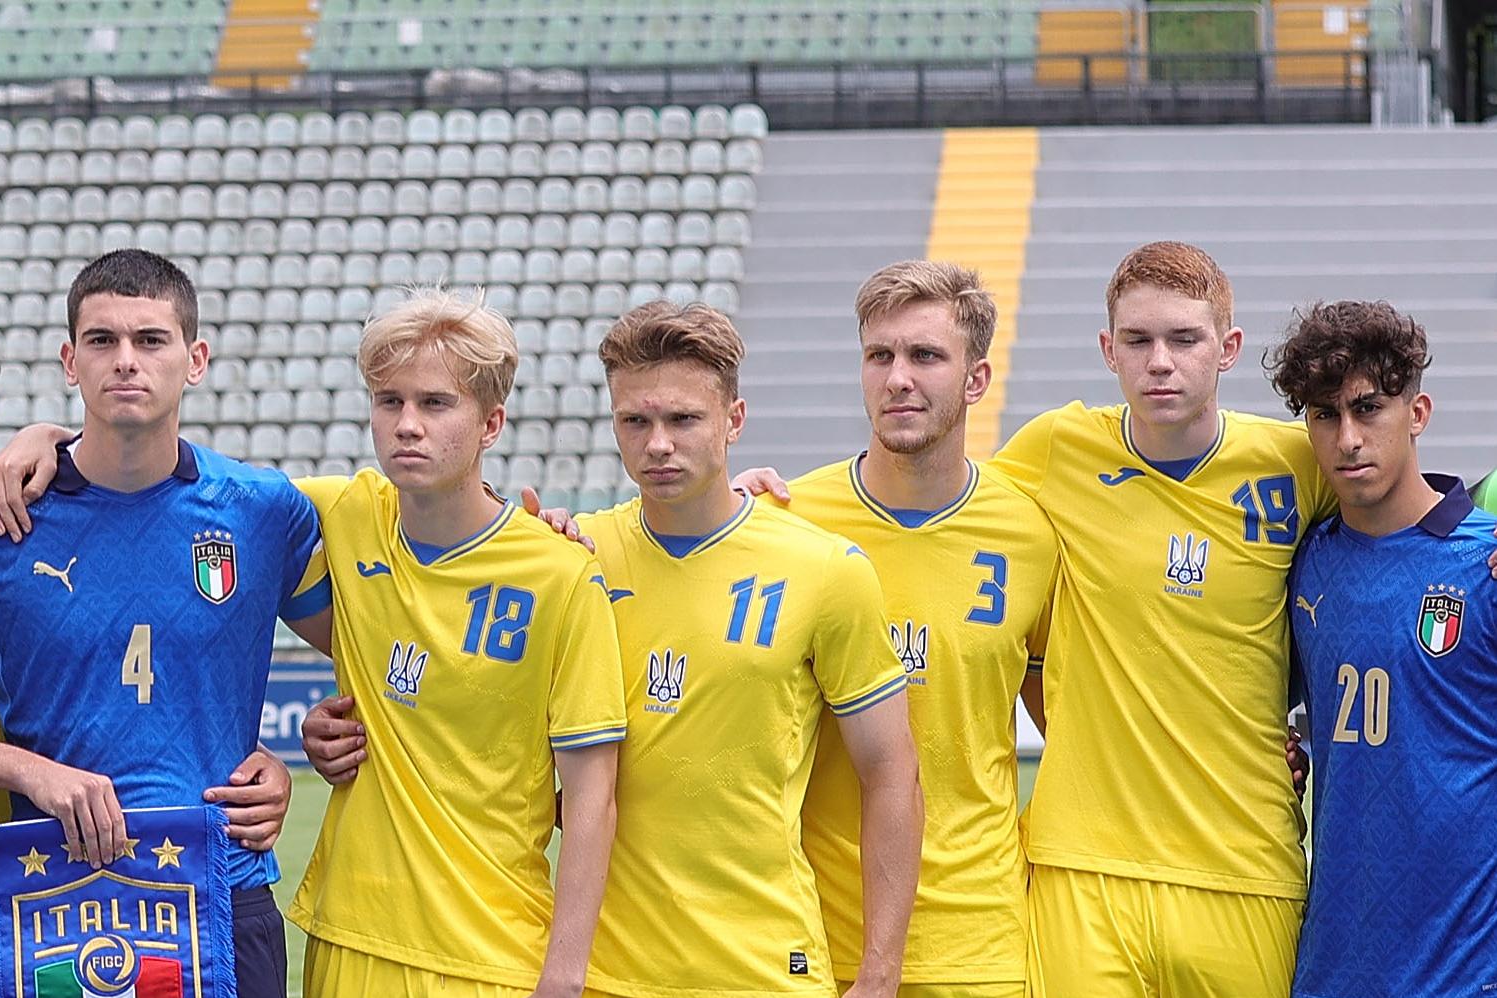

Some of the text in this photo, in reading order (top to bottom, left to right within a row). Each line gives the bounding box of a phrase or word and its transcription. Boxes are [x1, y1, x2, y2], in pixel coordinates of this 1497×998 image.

[1230, 474, 1300, 544] 19
[196, 545, 231, 557] ITALIA
[461, 582, 536, 663] 18
[725, 574, 788, 648] 11
[965, 550, 1008, 626] 3
[1164, 585, 1204, 598] UKRAINE
[1426, 598, 1461, 613] ITALIA
[122, 624, 154, 704] 4
[1333, 663, 1390, 746] 20
[33, 898, 178, 944] ITALIA
[92, 956, 123, 969] FIGC
